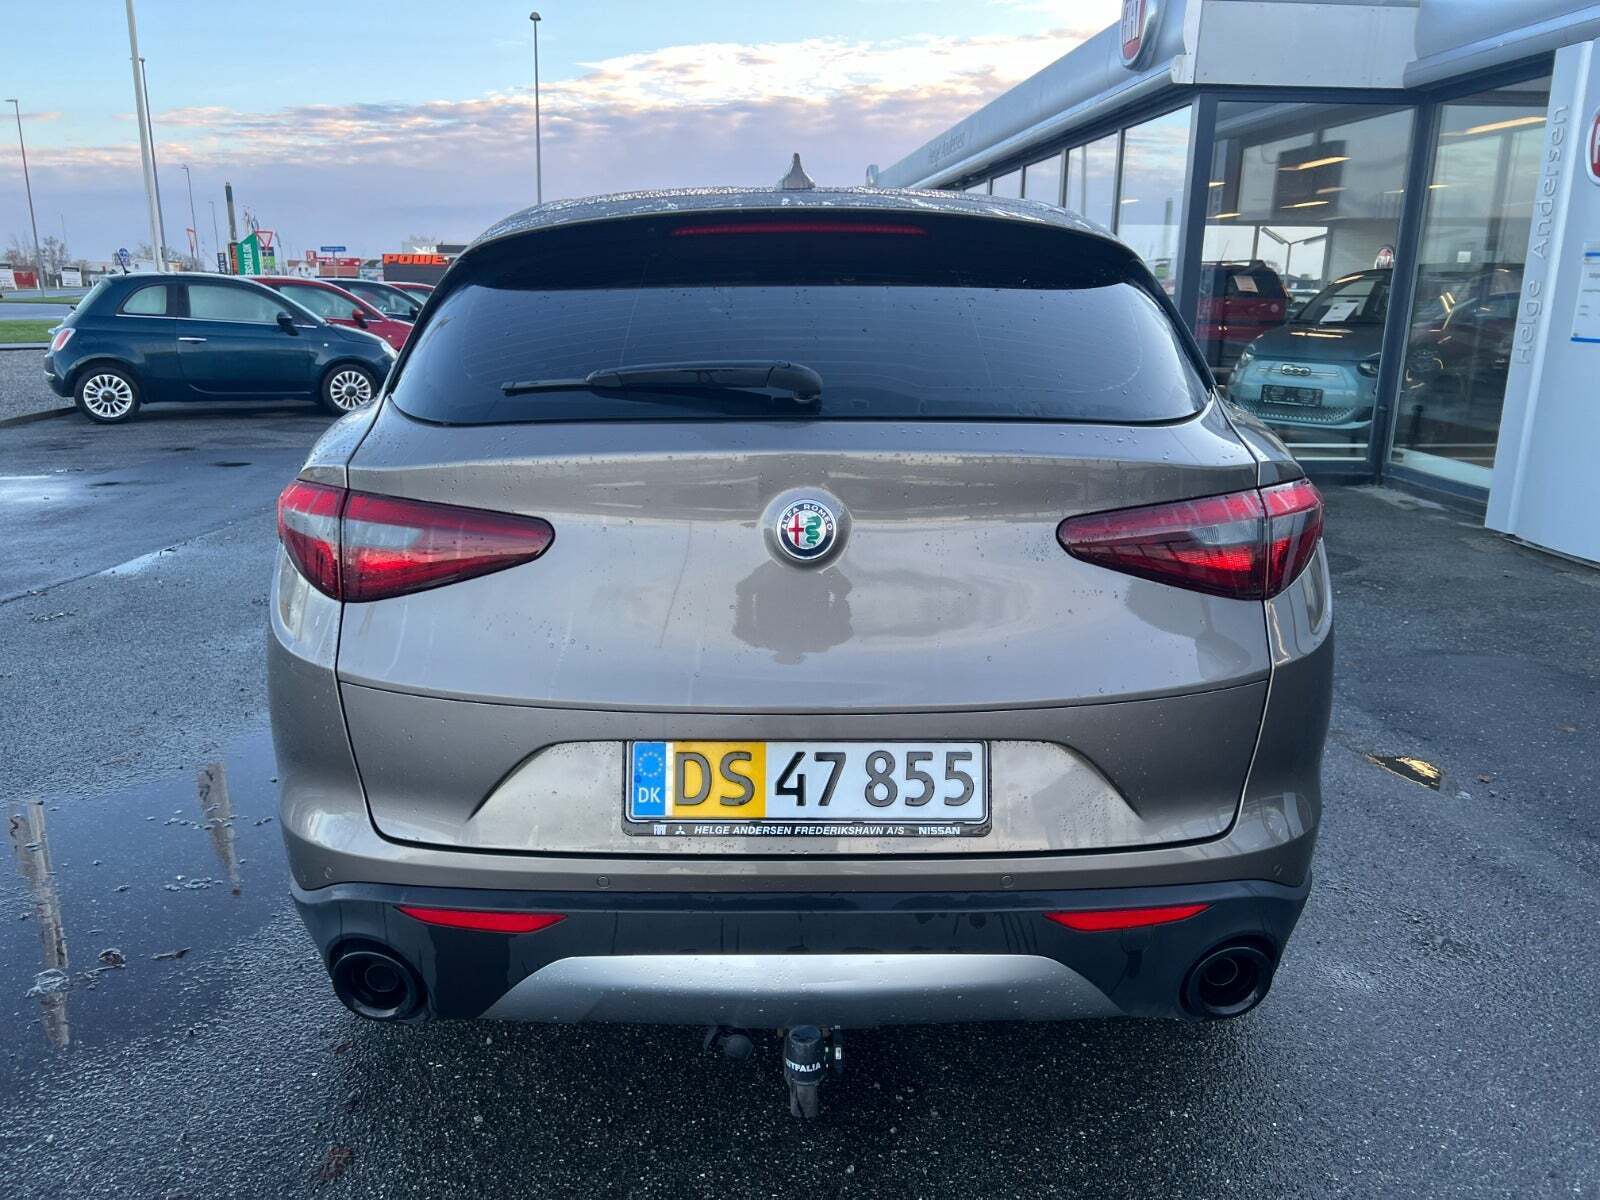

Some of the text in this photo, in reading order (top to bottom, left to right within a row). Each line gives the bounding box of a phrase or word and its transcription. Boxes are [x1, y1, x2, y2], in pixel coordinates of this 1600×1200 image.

[1515, 104, 1568, 365] Helge Andersen
[383, 253, 449, 265] POWE
[781, 503, 833, 531] ALFA ROMEO
[674, 750, 975, 808] DS 47 855
[637, 787, 661, 804] DK
[694, 826, 905, 836] HELGE ANDERSEN FREDERIKSHAVN A/S
[918, 826, 961, 835] NISSAN
